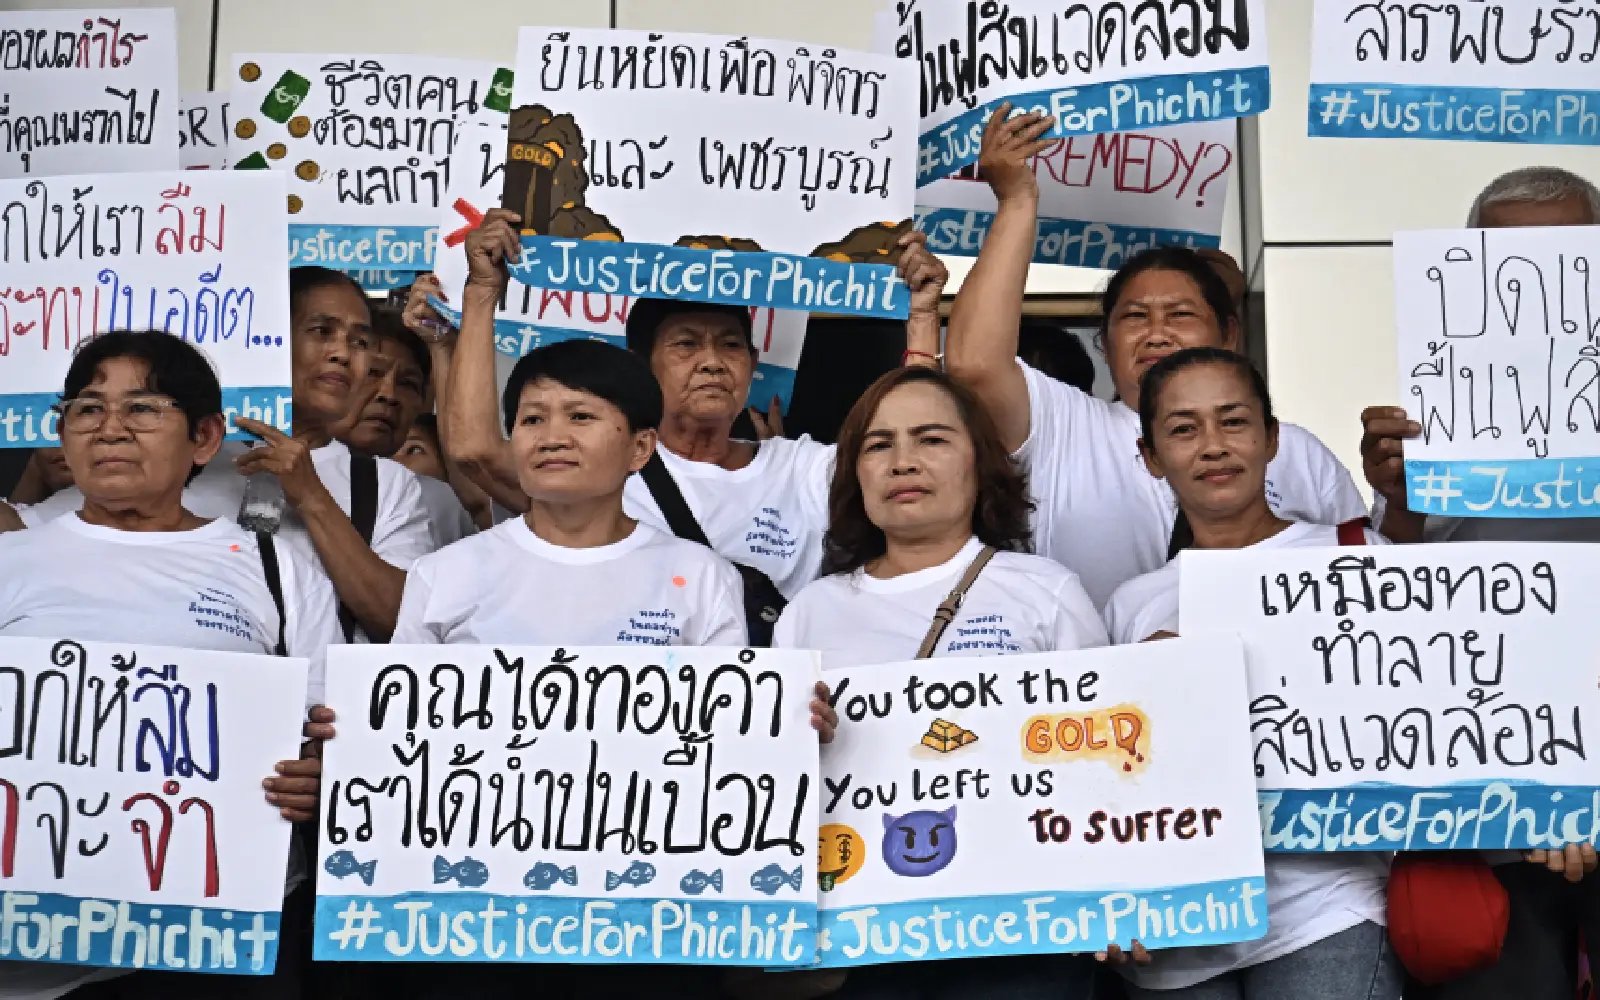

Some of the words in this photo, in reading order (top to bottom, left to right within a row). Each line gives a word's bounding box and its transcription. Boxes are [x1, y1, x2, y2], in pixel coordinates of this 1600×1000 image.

[0, 16, 149, 71] องผลกำไร
[320, 59, 479, 115] ชีวิตคน
[337, 156, 451, 208] ผลกำไ
[590, 135, 674, 190] และ
[699, 126, 893, 212] เพชรบูรณ์
[508, 239, 900, 310] #JusticeForPhichit
[1260, 555, 1558, 616] เหมืองทอง
[1312, 619, 1504, 687] ทำลาย
[369, 648, 783, 762] คุณได้ทองคำ
[902, 674, 1003, 714] took
[1017, 668, 1100, 704] the
[1025, 711, 1144, 758] GOLD
[1249, 674, 1587, 778] สิ่งแวดล้อม
[325, 730, 809, 857] เราได้น้ำปนเปื้อน
[824, 773, 898, 813] You
[1011, 769, 1055, 797] us
[328, 900, 810, 963] #JusticeForPhichit
